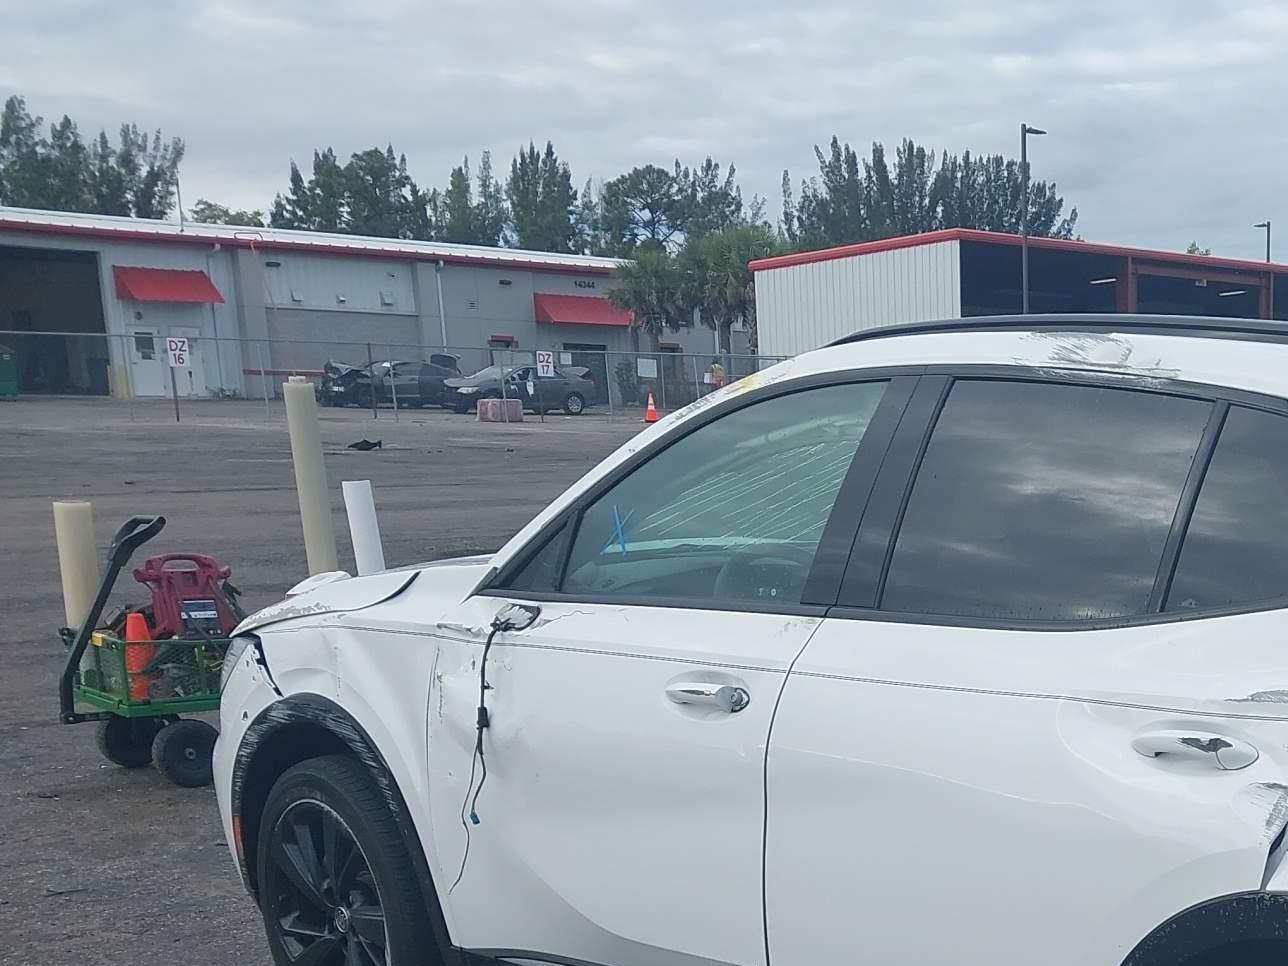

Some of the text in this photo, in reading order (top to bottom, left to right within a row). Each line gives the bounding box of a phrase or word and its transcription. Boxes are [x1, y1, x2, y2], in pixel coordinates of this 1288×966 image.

[169, 340, 187, 352] DZ
[173, 353, 185, 365] 16
[538, 352, 552, 364] DZ
[541, 364, 550, 375] 17
